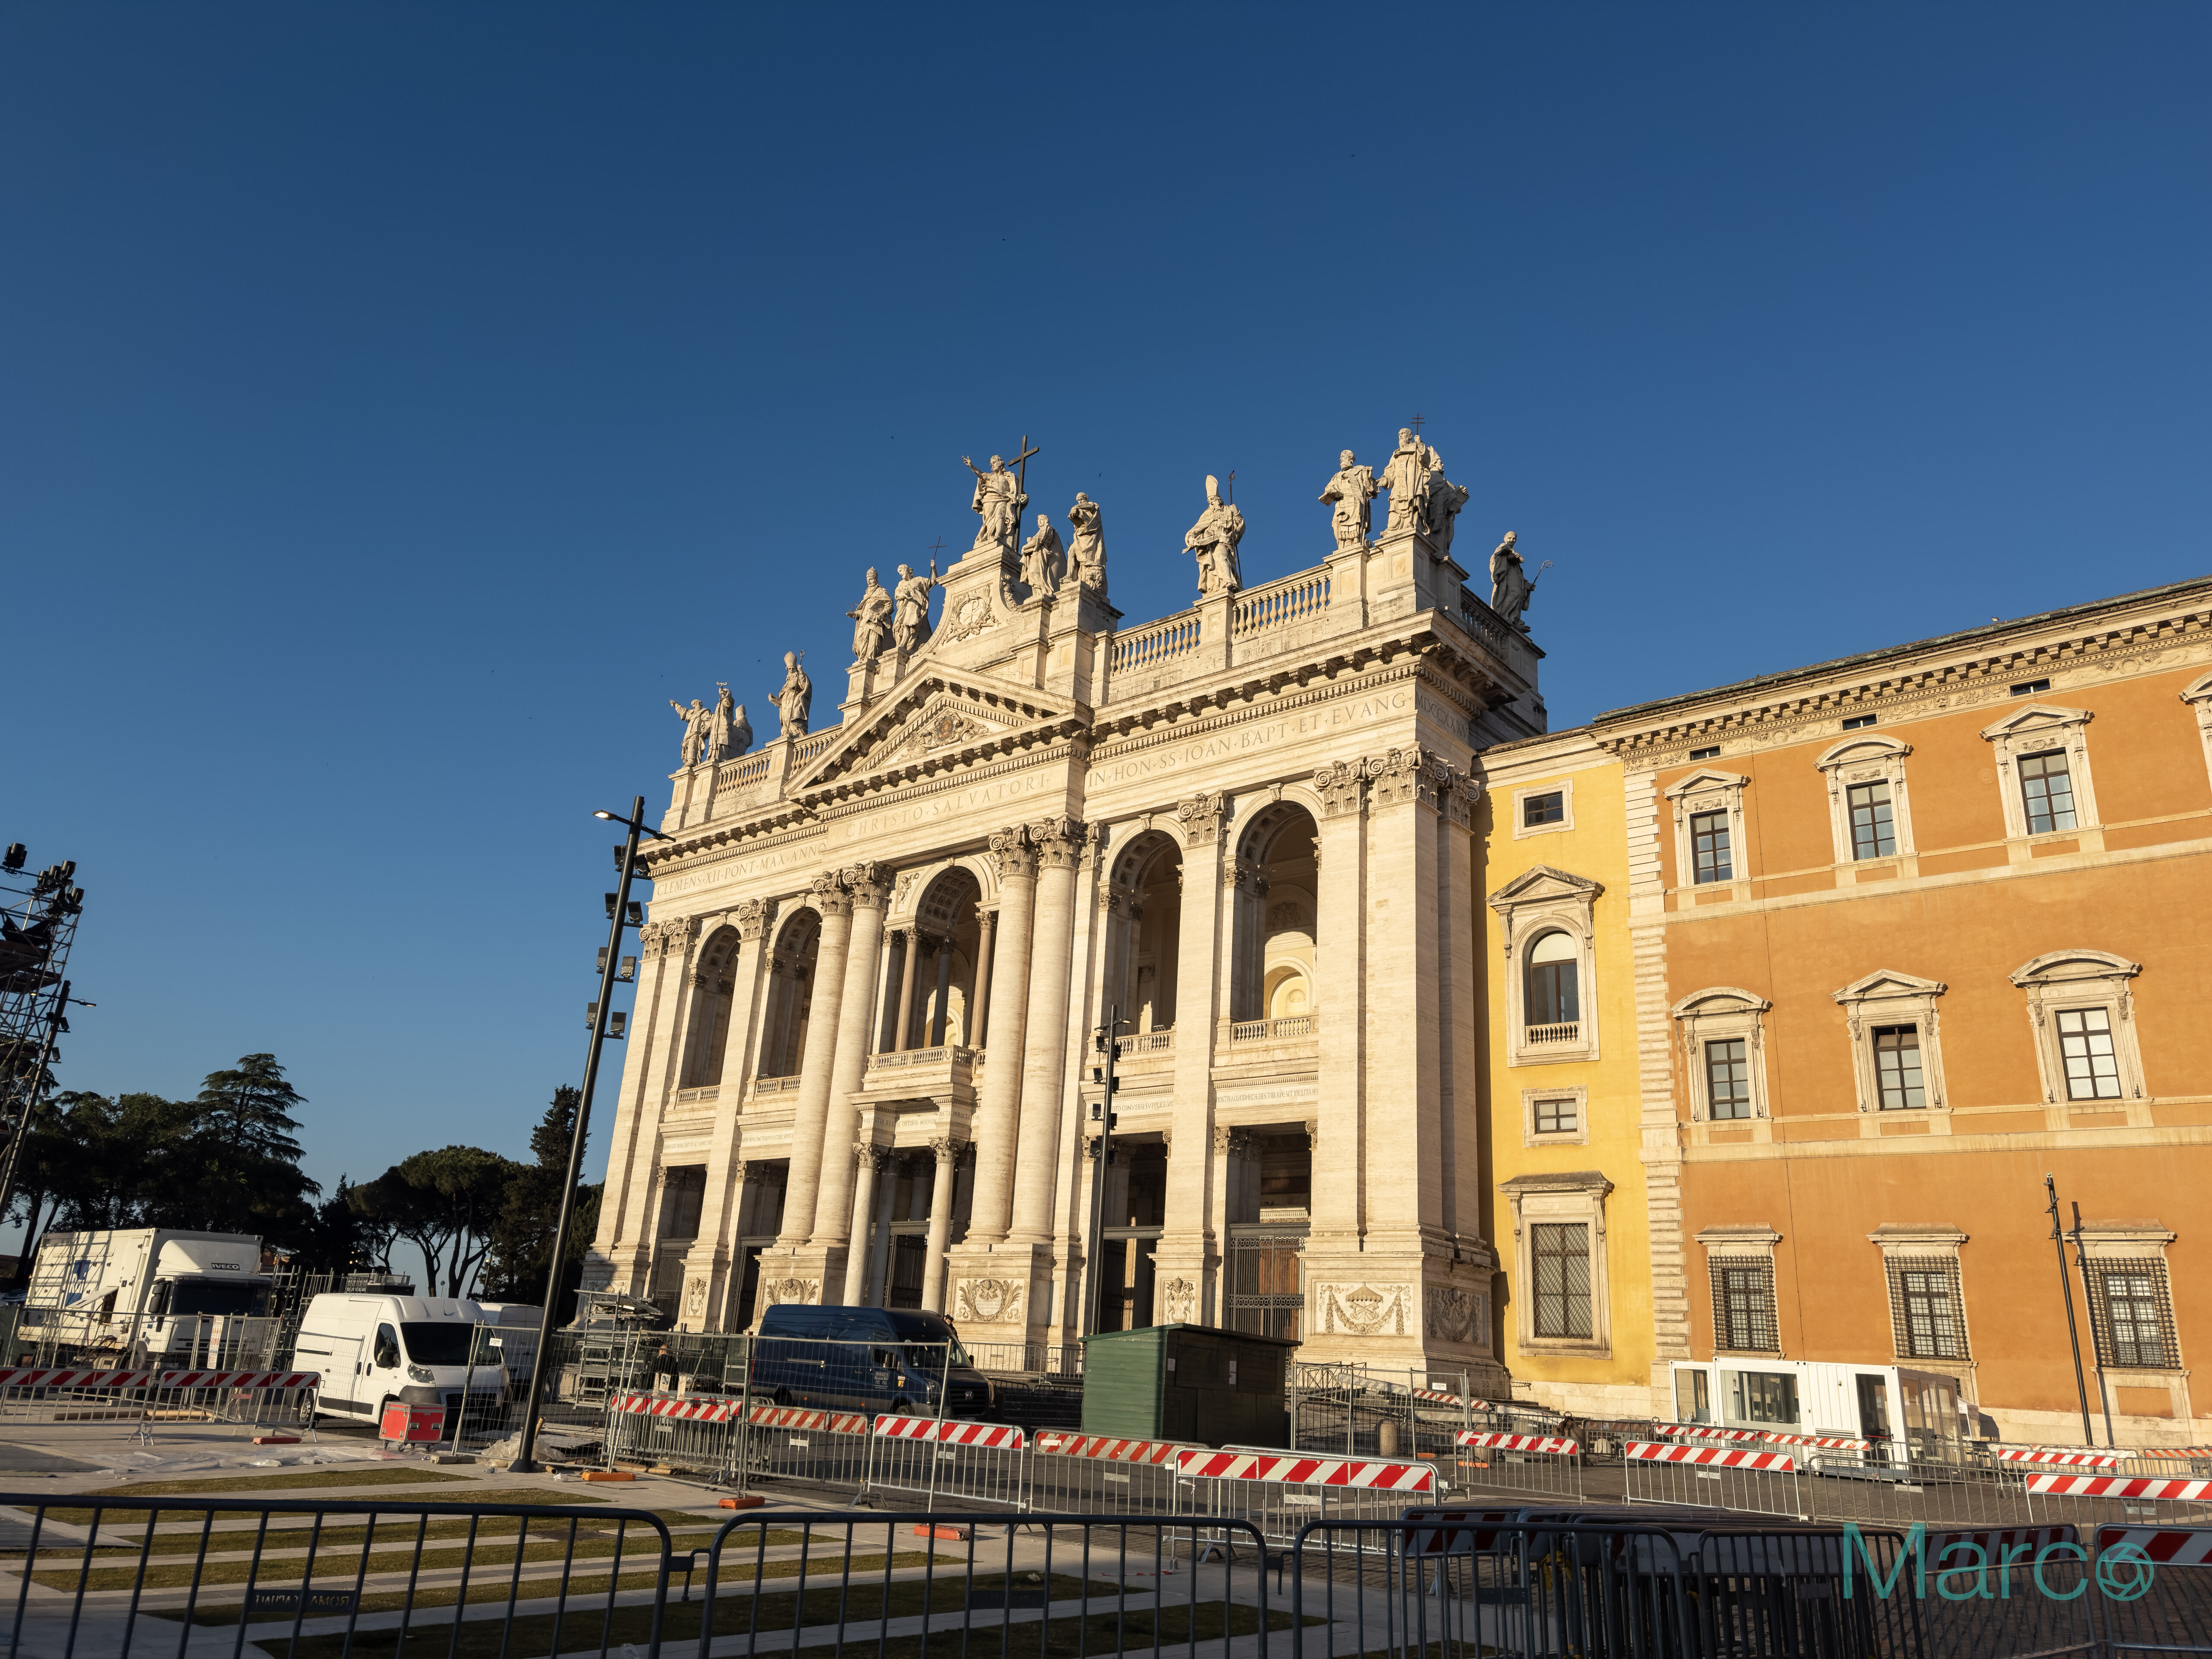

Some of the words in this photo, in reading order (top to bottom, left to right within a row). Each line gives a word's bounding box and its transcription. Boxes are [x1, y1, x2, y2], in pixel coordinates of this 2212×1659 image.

[1088, 769, 1106, 787] IN
[1114, 758, 1151, 781] HON
[1160, 752, 1176, 769] SS
[1185, 737, 1231, 763] IOAN
[1241, 722, 1289, 748] BAPT
[1298, 713, 1321, 734] ET
[1332, 692, 1406, 725] EVANG
[847, 807, 922, 837] CHRISTO
[932, 773, 1044, 815] SALVATORI
[657, 874, 702, 896] CLEMENS
[705, 870, 721, 884] XII
[724, 861, 756, 879] PONT
[760, 852, 786, 871] MAX
[790, 843, 826, 863] ANNO
[1145, 1101, 1166, 1109] SVPPLICE
